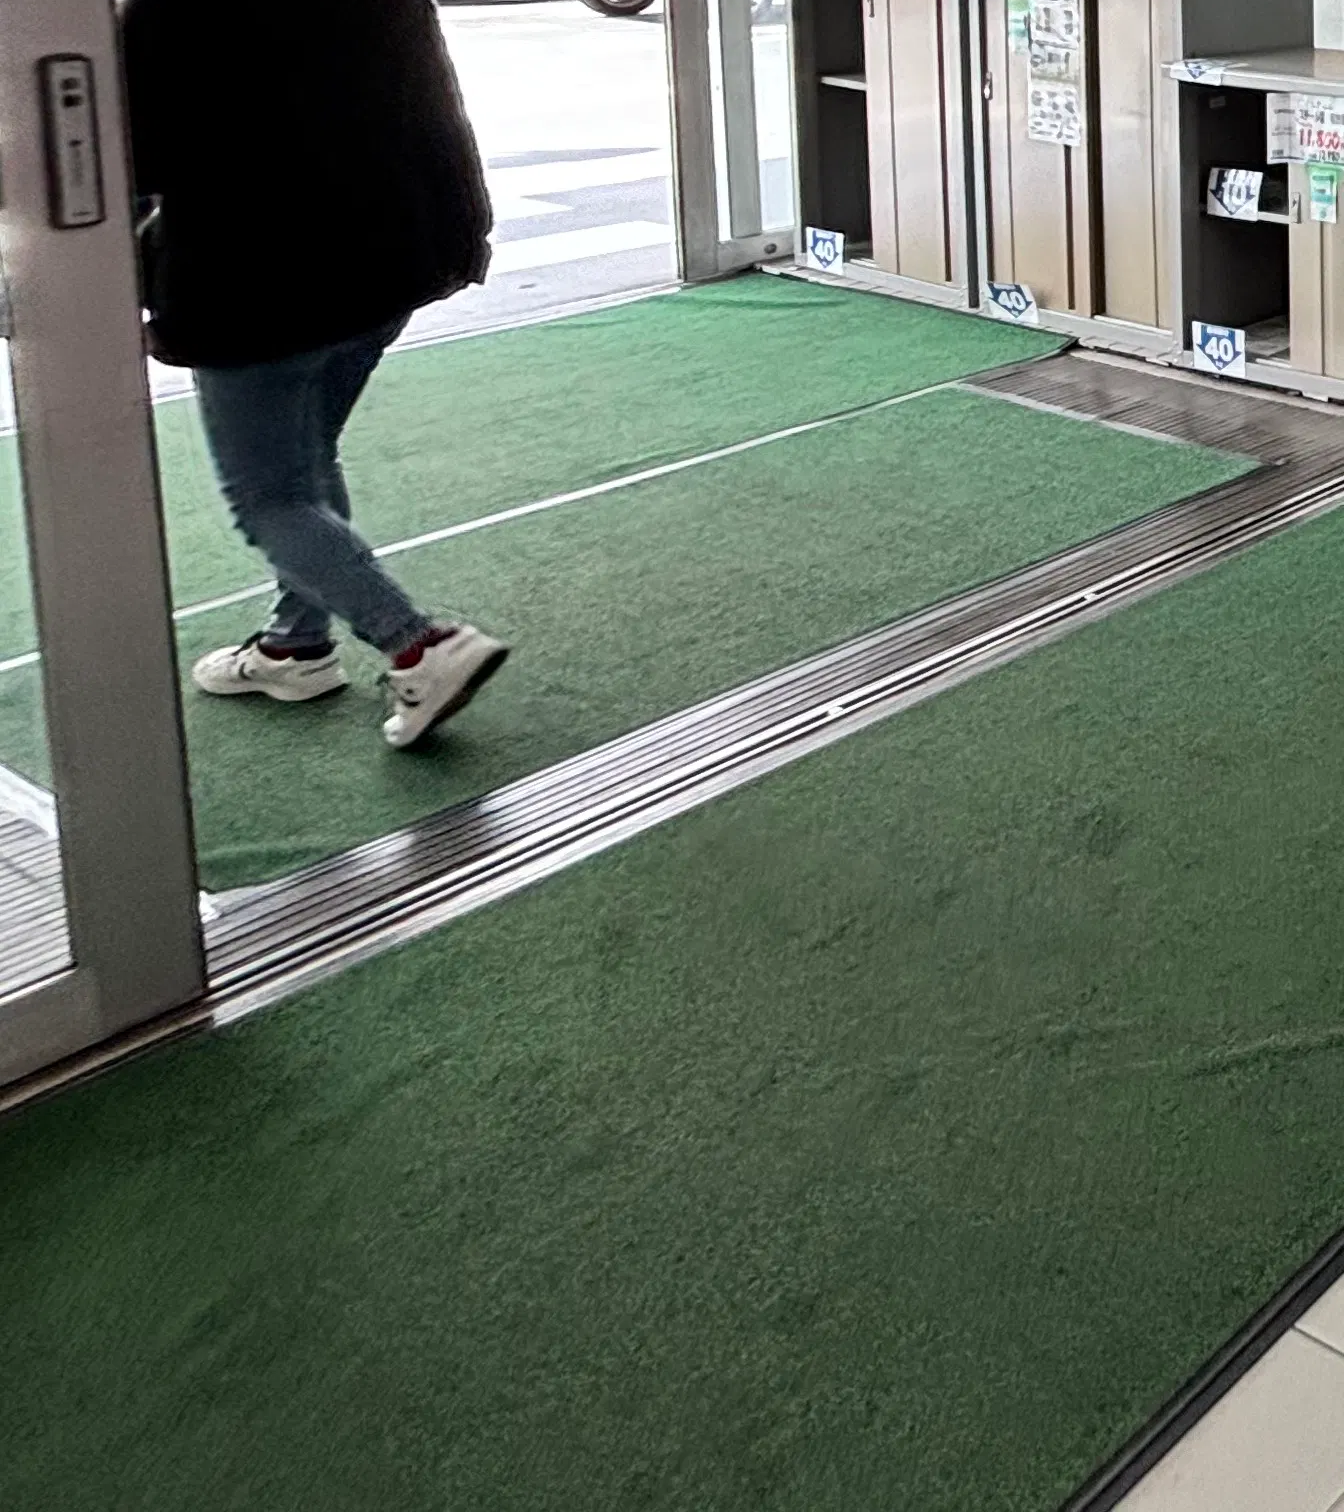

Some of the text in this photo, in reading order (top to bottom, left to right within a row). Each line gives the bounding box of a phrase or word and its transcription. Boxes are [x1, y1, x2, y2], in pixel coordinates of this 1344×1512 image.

[814, 240, 834, 261] 40
[998, 291, 1026, 311] 40
[1205, 337, 1234, 362] 40
